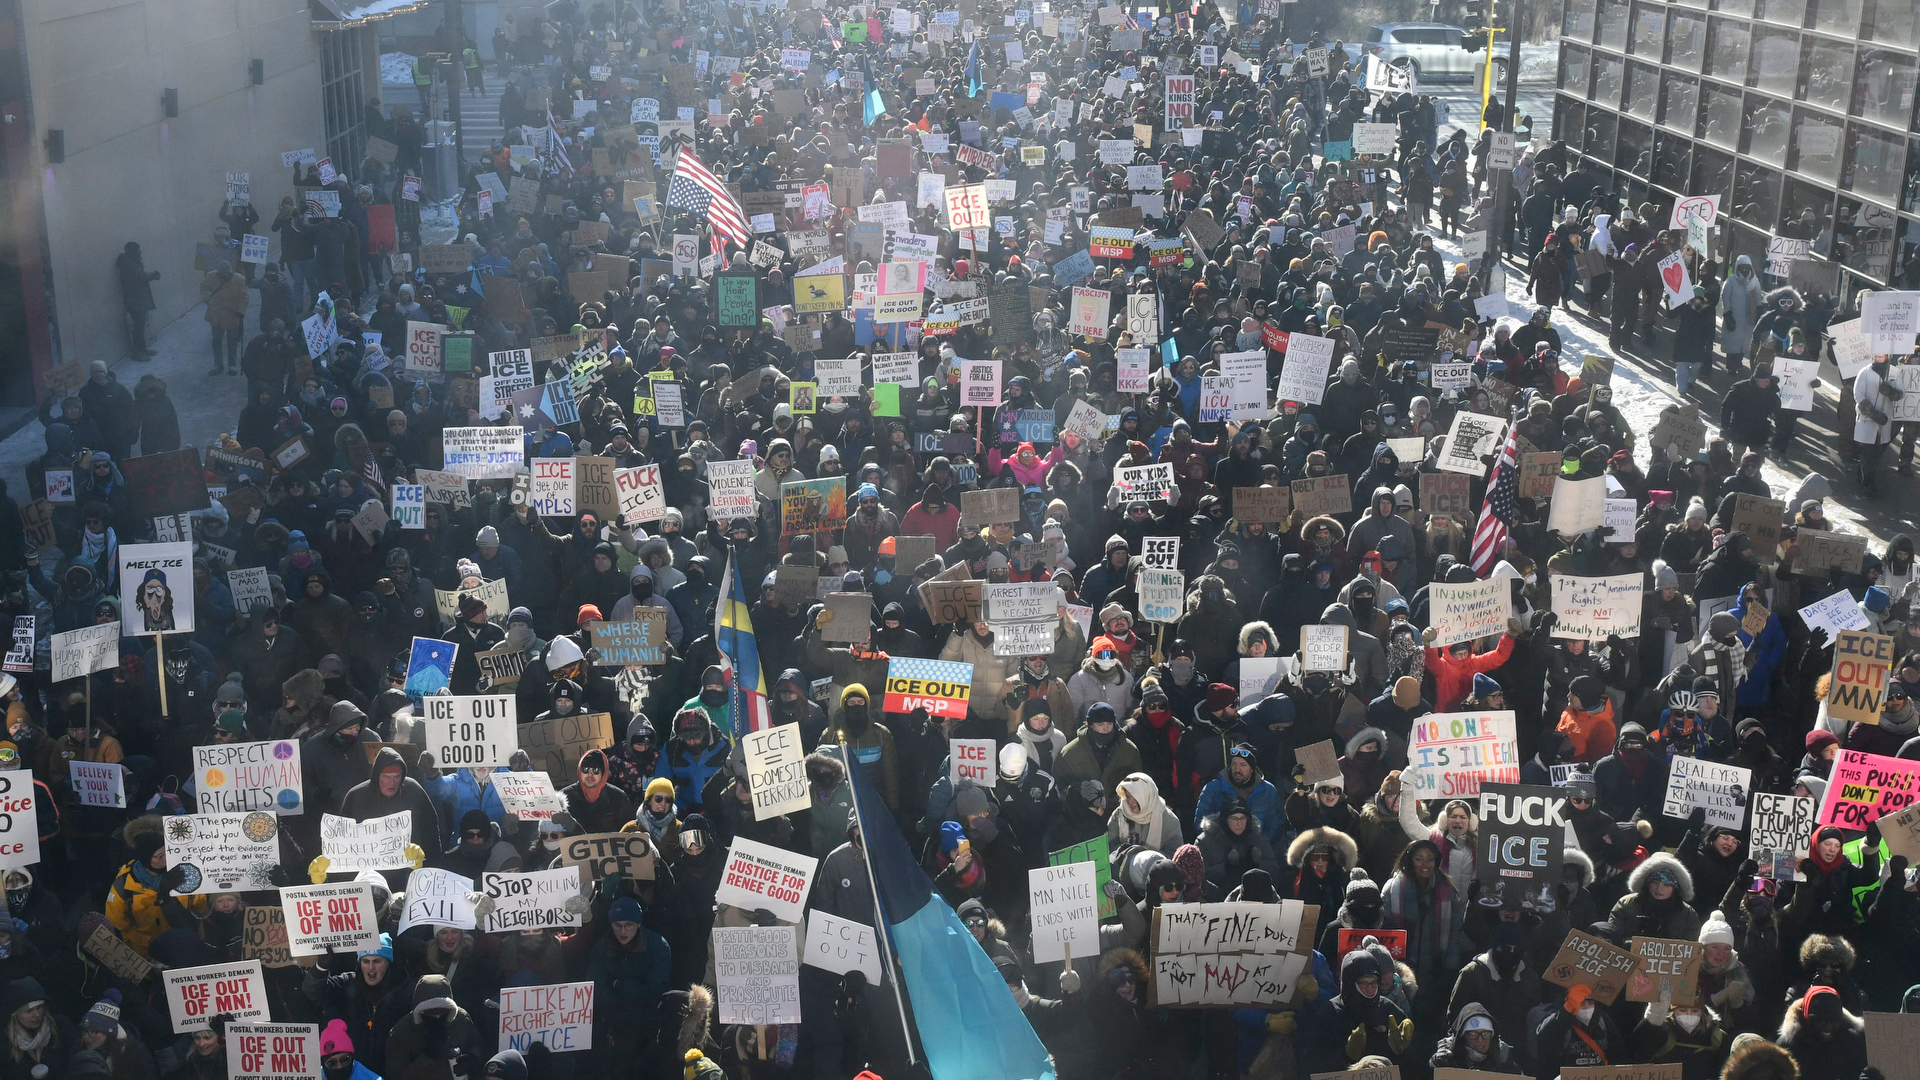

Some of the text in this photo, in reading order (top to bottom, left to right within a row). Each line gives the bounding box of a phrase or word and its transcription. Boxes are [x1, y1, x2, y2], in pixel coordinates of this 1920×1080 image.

[1310, 51, 1325, 59] ONE
[1169, 80, 1193, 93] NO
[1169, 94, 1193, 102] KINGS
[1169, 105, 1193, 118] NO
[1169, 118, 1183, 130] IC
[1498, 137, 1507, 146] NO
[959, 145, 994, 169] MURDER
[1492, 148, 1512, 157] STOPPING
[951, 194, 981, 210] ICE
[1076, 191, 1085, 199] MN
[953, 210, 984, 226] OUT!
[245, 236, 267, 246] ICE
[805, 230, 826, 239] WORLD
[792, 245, 829, 254] WATCHING
[1092, 238, 1132, 247] ICE OUT
[245, 248, 267, 259] OUT
[678, 246, 694, 258] ICE
[1101, 248, 1122, 256] MSP
[1167, 247, 1183, 255] OUT
[1660, 253, 1680, 268] MPLS
[722, 278, 749, 289] Do you
[726, 287, 748, 295] Hear
[1074, 289, 1109, 299] FASCISM
[725, 297, 753, 310] People
[721, 309, 754, 325] Sing?
[415, 331, 436, 342] ICE
[1075, 325, 1104, 336] IS HERE
[1263, 327, 1287, 345] ABOLISH
[410, 342, 440, 355] OUT
[1267, 337, 1277, 346] ICE
[495, 351, 526, 365] KILLER
[492, 362, 531, 378] ICE
[513, 377, 532, 385] OUR
[1204, 378, 1235, 389] HE WAS
[548, 382, 573, 403] ICE
[1205, 396, 1230, 408] ICU
[554, 402, 579, 424] OUT
[1022, 412, 1053, 421] ABOLISH
[1201, 408, 1232, 421] NURSE
[1026, 423, 1052, 441] ICE
[445, 452, 523, 464] LIBERTY JUSTICE
[536, 463, 572, 479] ICE
[582, 464, 610, 484] ICE
[711, 464, 752, 476] YOU CHOSE
[1123, 469, 1168, 481] OUR KIDS
[536, 482, 568, 491] get out
[617, 467, 659, 491] FUCK
[711, 477, 753, 489] VIOLENCE
[1135, 480, 1172, 491] DESERVE
[1424, 476, 1469, 495] FUCK
[397, 486, 423, 502] ICE
[582, 484, 610, 505] GTFO
[623, 487, 661, 512] ICE!
[720, 488, 746, 496] because
[1121, 489, 1161, 501] BETTER
[534, 499, 573, 514] MPLS
[713, 495, 754, 507] LEARNING
[1431, 496, 1467, 513] ICE!
[395, 507, 424, 525] OUT!
[715, 507, 752, 516] WAS HARD
[1147, 541, 1176, 553] ICE
[126, 560, 184, 570] MELT ICE
[1146, 554, 1175, 565] OUT
[1571, 594, 1602, 606] Rights
[1594, 608, 1612, 617] NOT
[597, 622, 650, 638] WHERE
[1315, 627, 1335, 636] NAZI
[1552, 621, 1639, 640] Mutually Exclusive!
[612, 635, 648, 645] IS OUR
[1307, 642, 1342, 653] COLDER
[1841, 635, 1890, 660] ICE
[1837, 661, 1889, 689] OUT
[888, 679, 969, 699] ICE OUT
[1834, 686, 1882, 713] MN
[430, 699, 508, 719] ICE OUT
[450, 723, 486, 742] FOR
[755, 731, 790, 756] ICE
[200, 743, 268, 768] RESPECT
[957, 745, 986, 760] ICE
[78, 767, 113, 780] BELIEVE
[236, 763, 302, 788] HUMAN
[957, 765, 987, 779] OUT
[1839, 770, 1861, 780] THIS
[86, 780, 109, 791] YOUR
[755, 779, 811, 806] TERRORIST
[88, 793, 110, 804] EYES
[202, 787, 274, 813] RIGHTS
[1841, 784, 1879, 803] DON'T
[1480, 793, 1566, 827] FUCK
[1756, 796, 1810, 816] ICE IS
[1831, 802, 1871, 823] FOR
[1752, 828, 1810, 849] GESTAPO
[569, 838, 651, 859] GTFO
[1488, 834, 1548, 867] ICE
[591, 857, 629, 880] ICE
[729, 859, 806, 892] JUSTICE FOR
[537, 876, 578, 895] KILLING
[727, 873, 801, 904] RENEE GOOD
[1033, 886, 1092, 905] MN NICE
[297, 897, 358, 919] ICE OUT
[300, 913, 362, 935] OF MN!
[489, 904, 574, 930] NEIGHBORS
[1568, 938, 1634, 972] ABOLISH
[1639, 942, 1693, 958] ABOLISH
[1577, 957, 1606, 976] ICE
[1646, 960, 1682, 975] ICE
[523, 987, 593, 1011] LIKE MY
[502, 1009, 593, 1034] RIGHTS WITH
[253, 1027, 283, 1035] WORKERS
